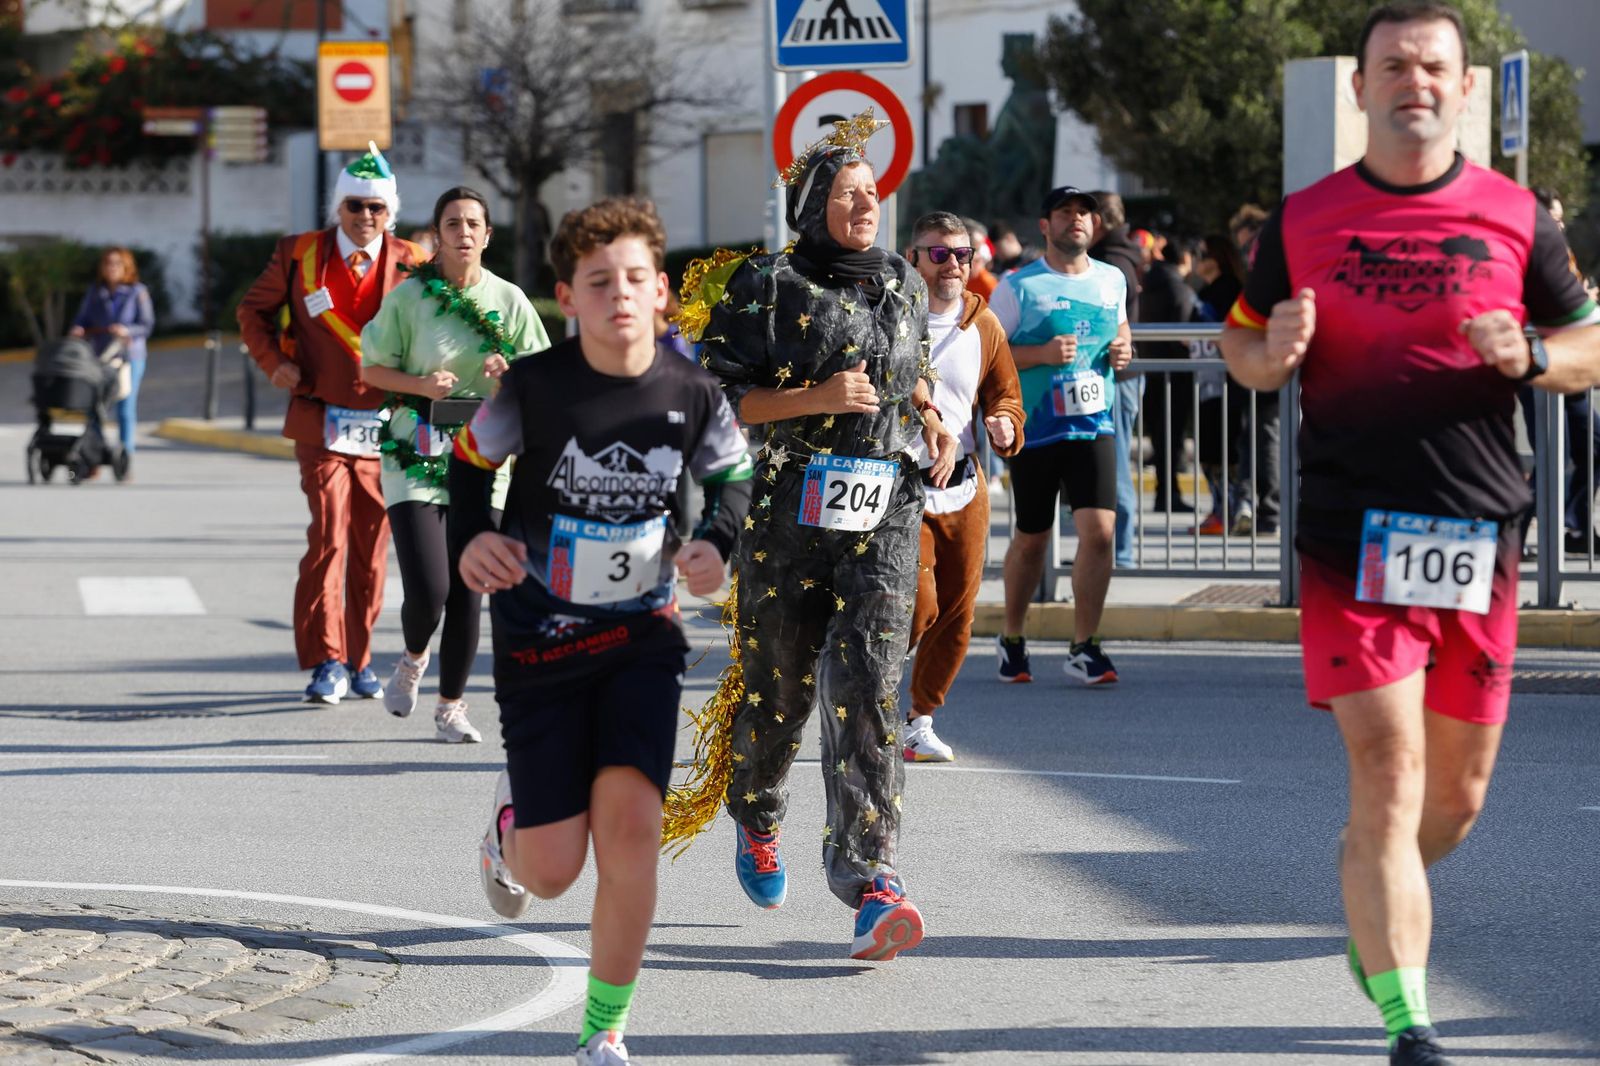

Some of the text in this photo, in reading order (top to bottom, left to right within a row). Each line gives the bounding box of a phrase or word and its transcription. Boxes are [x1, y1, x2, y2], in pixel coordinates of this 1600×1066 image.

[1067, 383, 1099, 404] 169
[808, 469, 823, 480] SAN
[832, 457, 895, 475] CARRERA
[806, 480, 820, 495] SIL
[803, 495, 822, 510] VES
[825, 479, 881, 514] 204
[558, 517, 578, 533] III
[801, 509, 821, 526] TRE
[607, 551, 631, 583] 3
[1396, 544, 1475, 586] 106
